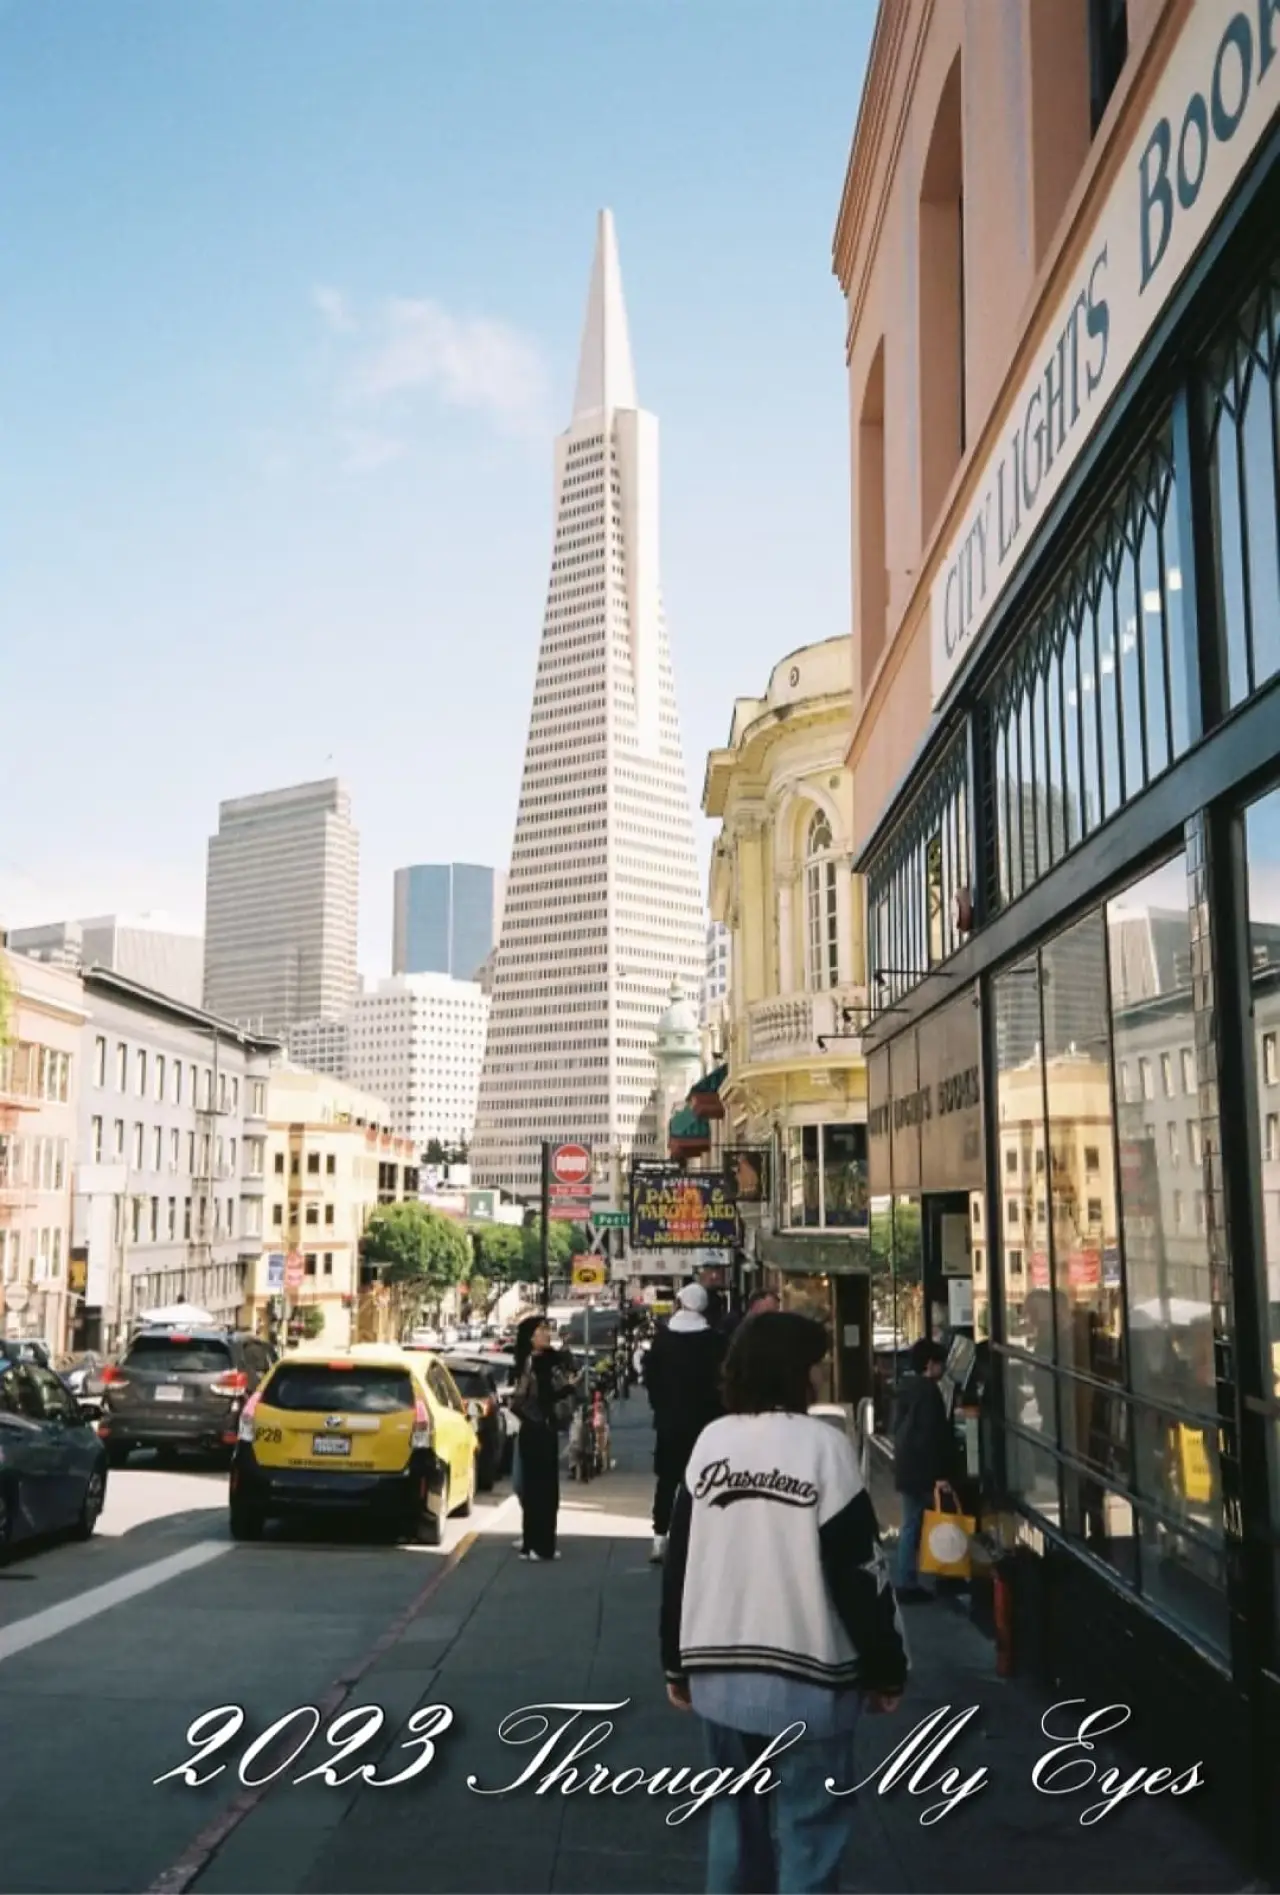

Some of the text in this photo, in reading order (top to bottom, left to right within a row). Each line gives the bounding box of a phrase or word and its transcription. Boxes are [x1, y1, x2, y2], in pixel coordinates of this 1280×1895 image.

[944, 492, 992, 660] CITY
[997, 240, 1110, 567] LIGHTS
[645, 1187, 704, 1203] PALM
[691, 1203, 735, 1220] CARD
[695, 1456, 818, 1501] Pasadena
